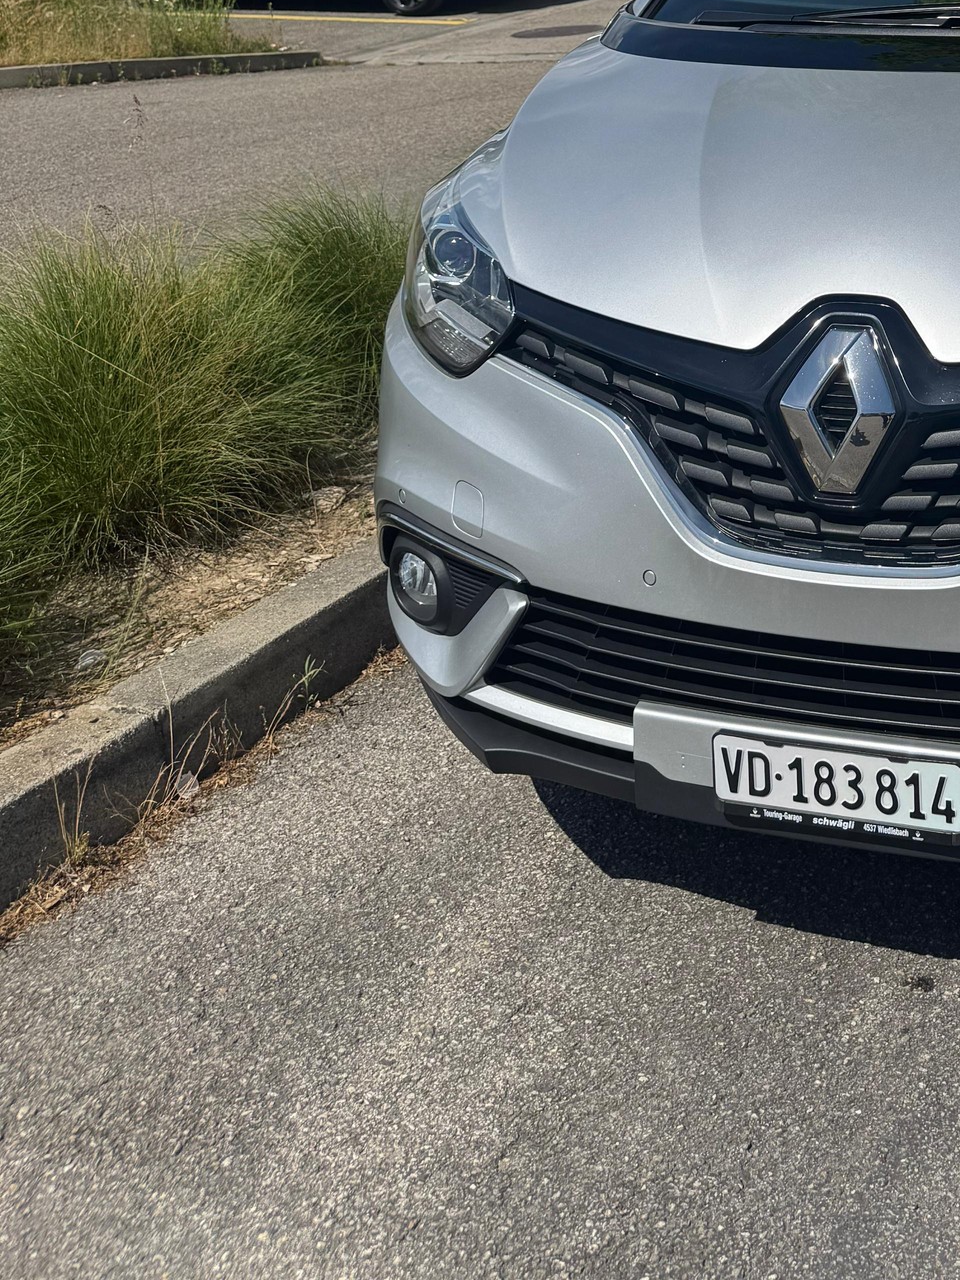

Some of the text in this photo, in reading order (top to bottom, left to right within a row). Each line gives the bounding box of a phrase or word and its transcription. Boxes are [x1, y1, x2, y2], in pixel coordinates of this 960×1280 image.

[763, 808, 909, 837] Touring-Garage schwägli 4537 Wiedlisbach
